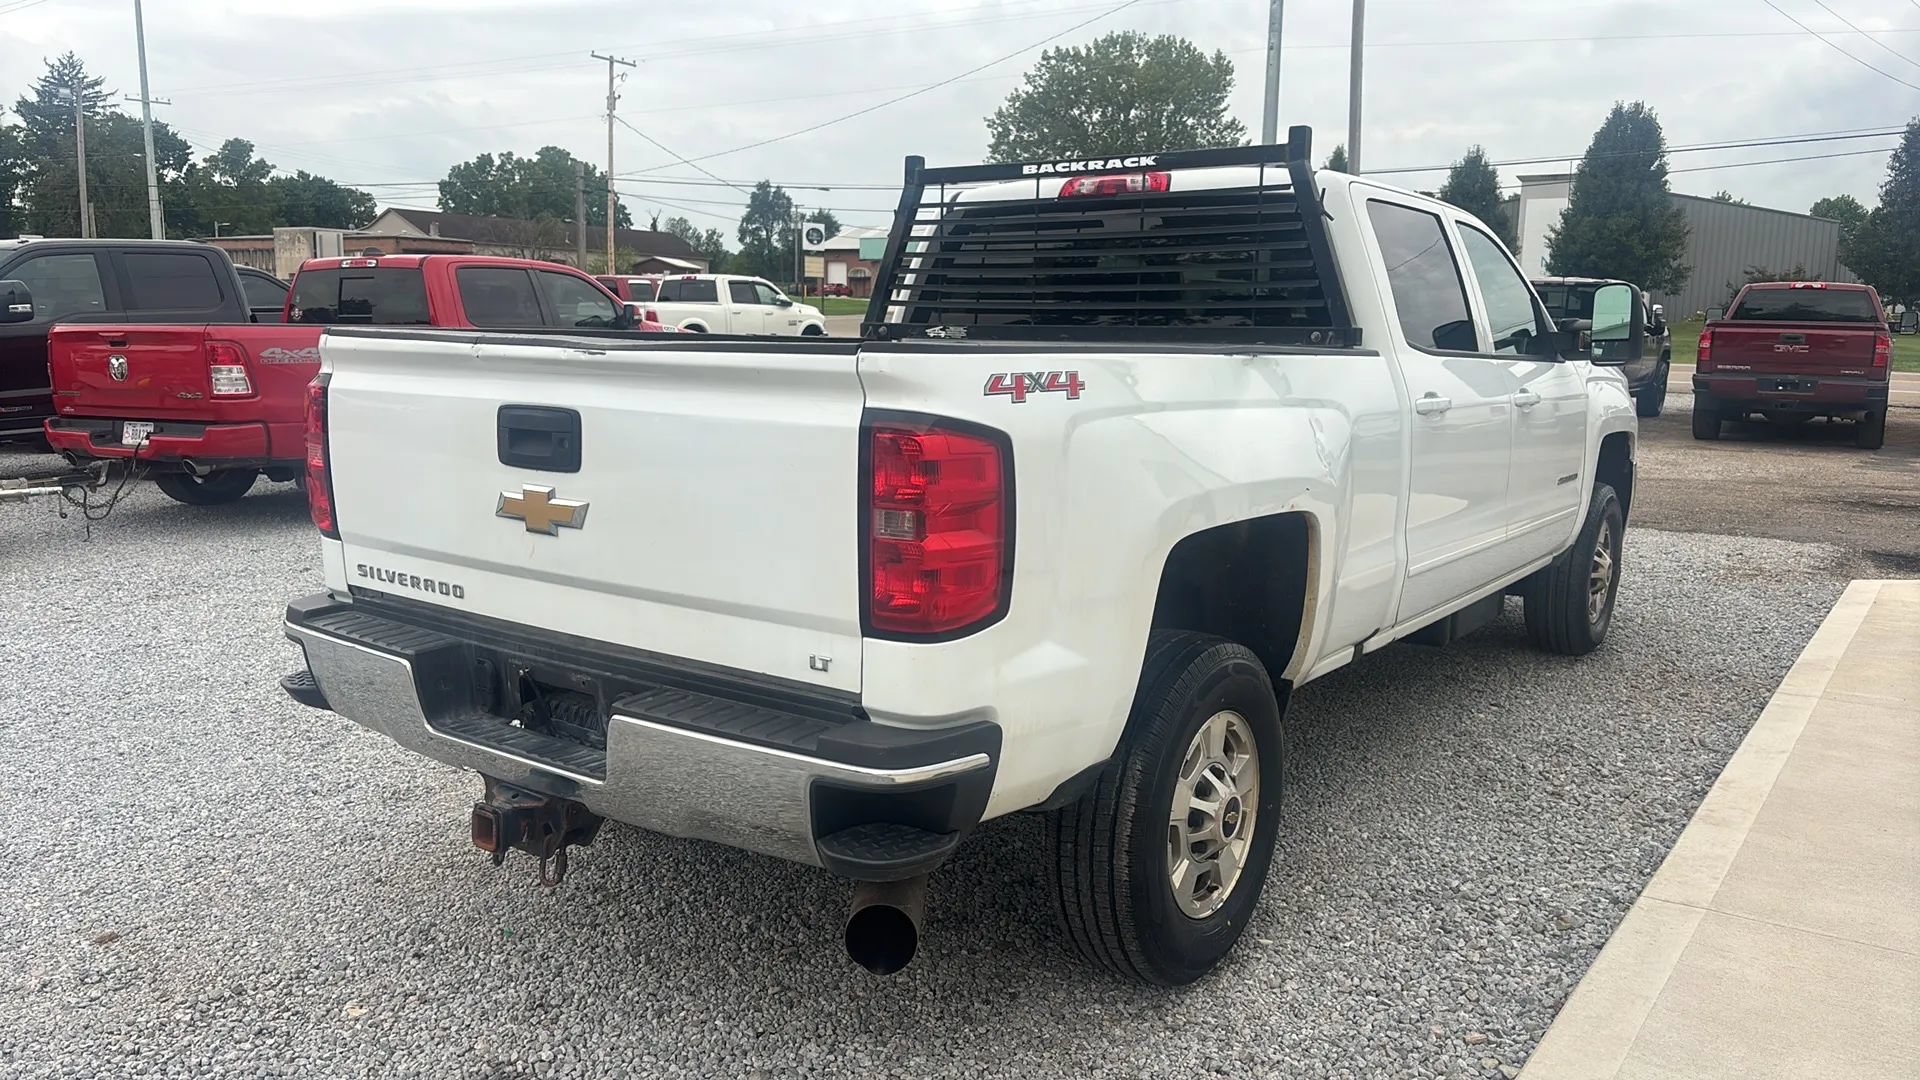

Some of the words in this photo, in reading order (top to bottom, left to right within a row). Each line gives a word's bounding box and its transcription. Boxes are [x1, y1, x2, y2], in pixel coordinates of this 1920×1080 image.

[1022, 155, 1159, 175] BACKRACK
[357, 563, 465, 600] SILVERADO
[809, 654, 833, 673] LT
